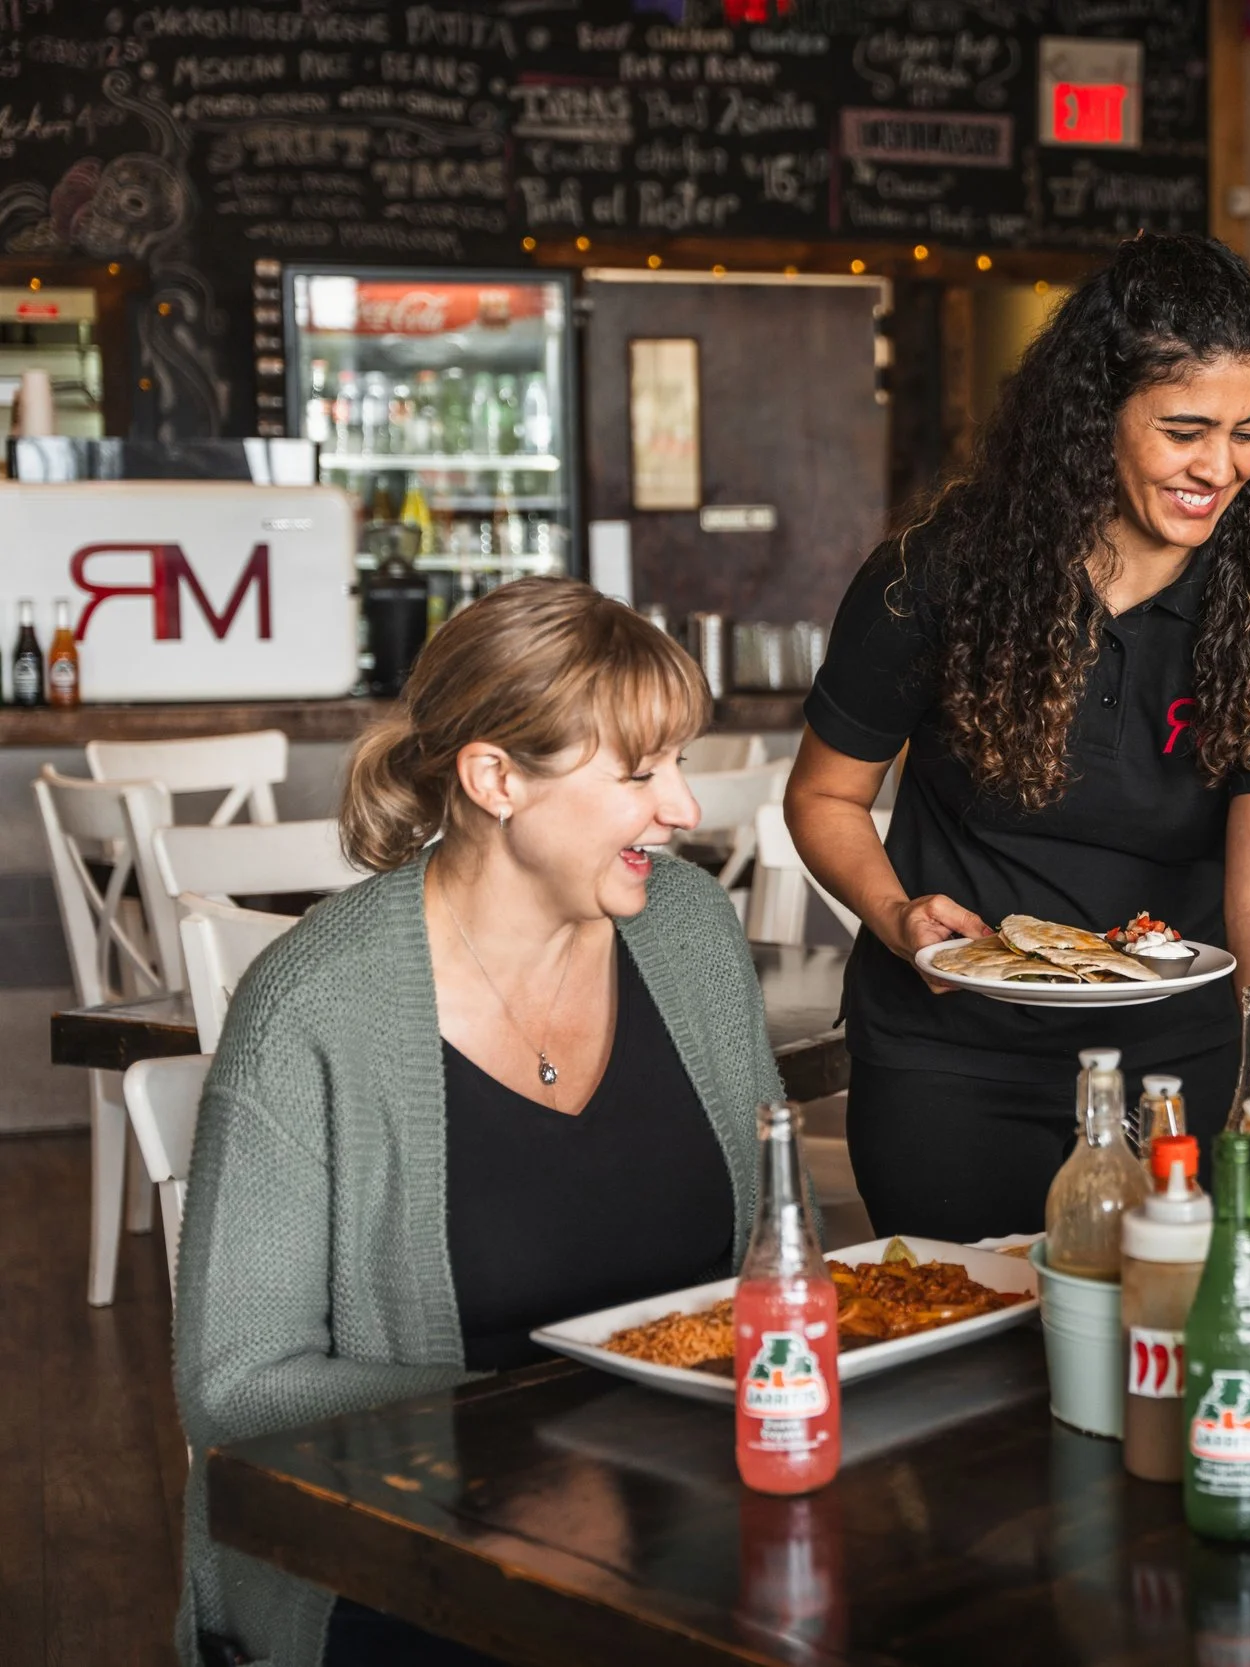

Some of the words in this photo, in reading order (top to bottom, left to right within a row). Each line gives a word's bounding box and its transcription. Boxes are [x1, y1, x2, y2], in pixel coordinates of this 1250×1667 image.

[380, 51, 480, 95] BEANS
[1053, 82, 1126, 143] EXIT
[206, 126, 371, 173] STREET
[371, 158, 507, 198] TACOS
